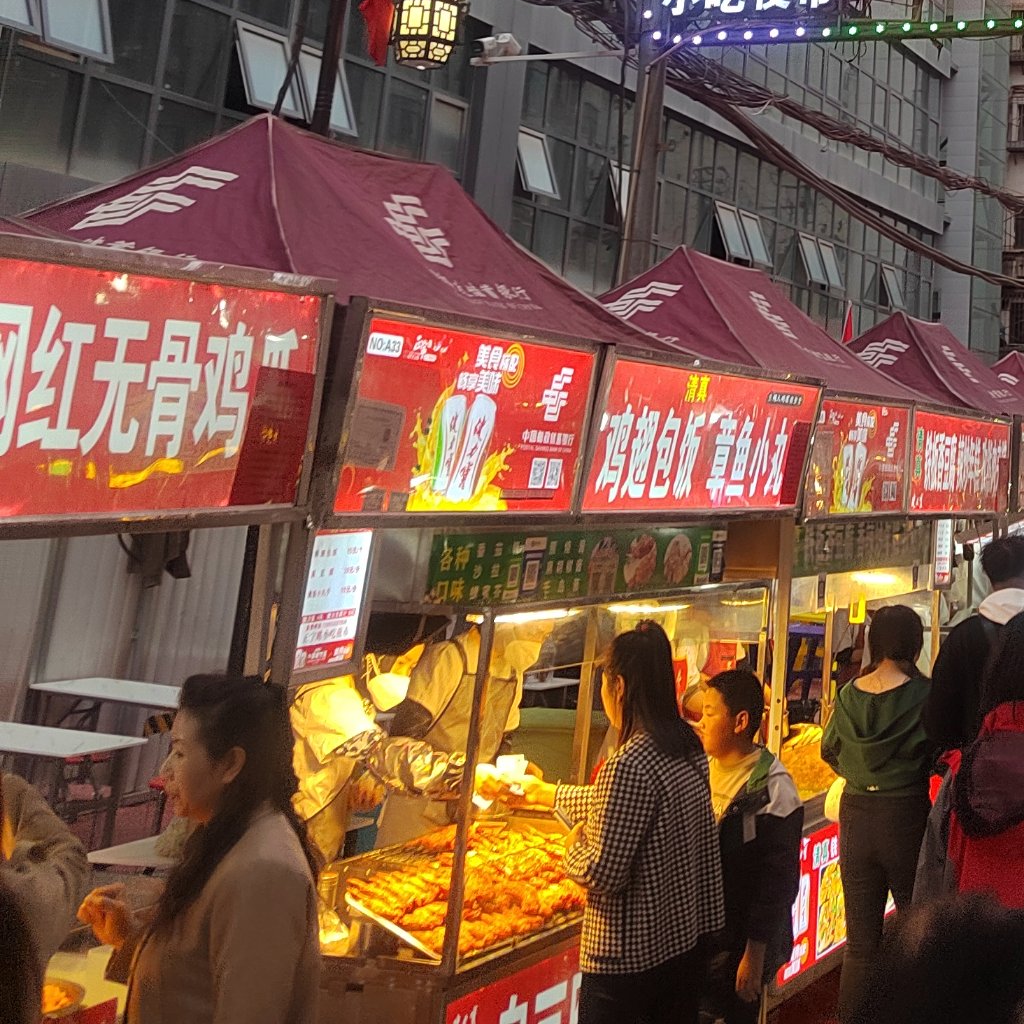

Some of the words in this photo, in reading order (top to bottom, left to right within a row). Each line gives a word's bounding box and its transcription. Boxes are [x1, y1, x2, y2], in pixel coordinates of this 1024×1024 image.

[685, 374, 711, 404] 清真
[594, 403, 706, 503] 鸡翅包饭
[440, 546, 471, 572] 各种
